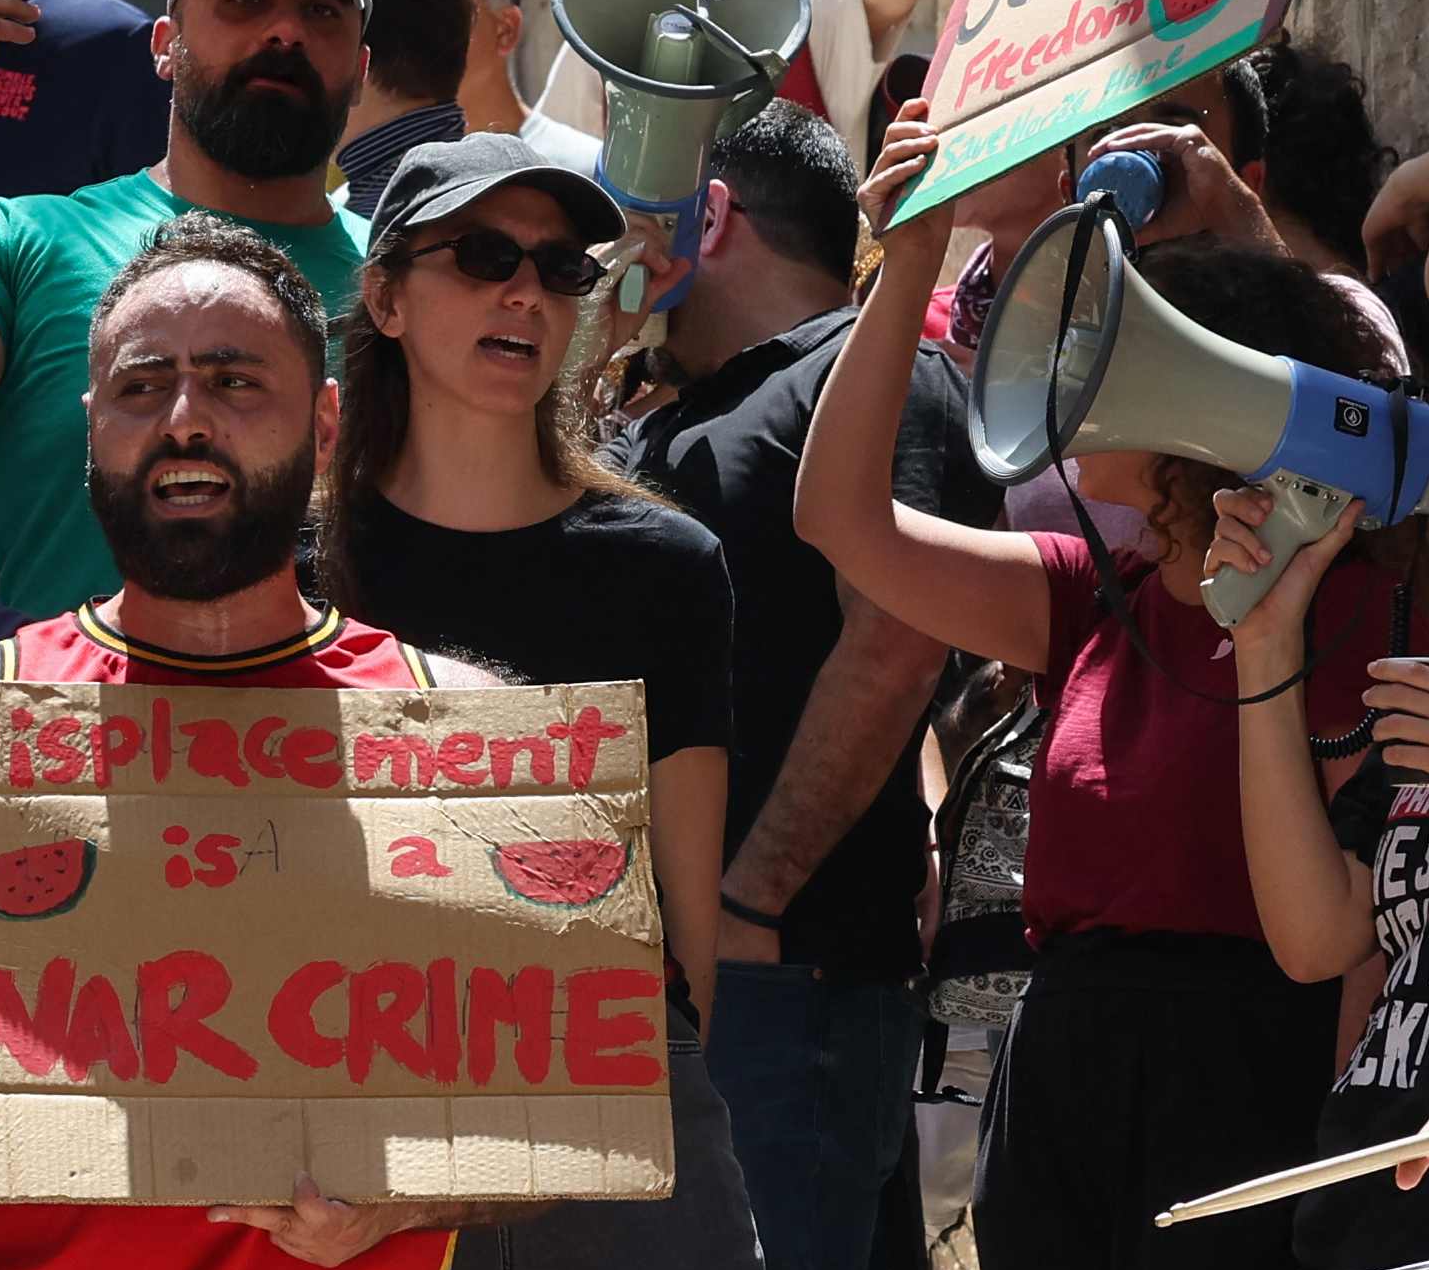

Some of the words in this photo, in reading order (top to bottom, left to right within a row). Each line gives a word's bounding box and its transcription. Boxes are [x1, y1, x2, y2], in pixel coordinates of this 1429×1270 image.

[161, 824, 243, 890] is
[387, 835, 453, 879] a
[266, 956, 668, 1087] CRIME
